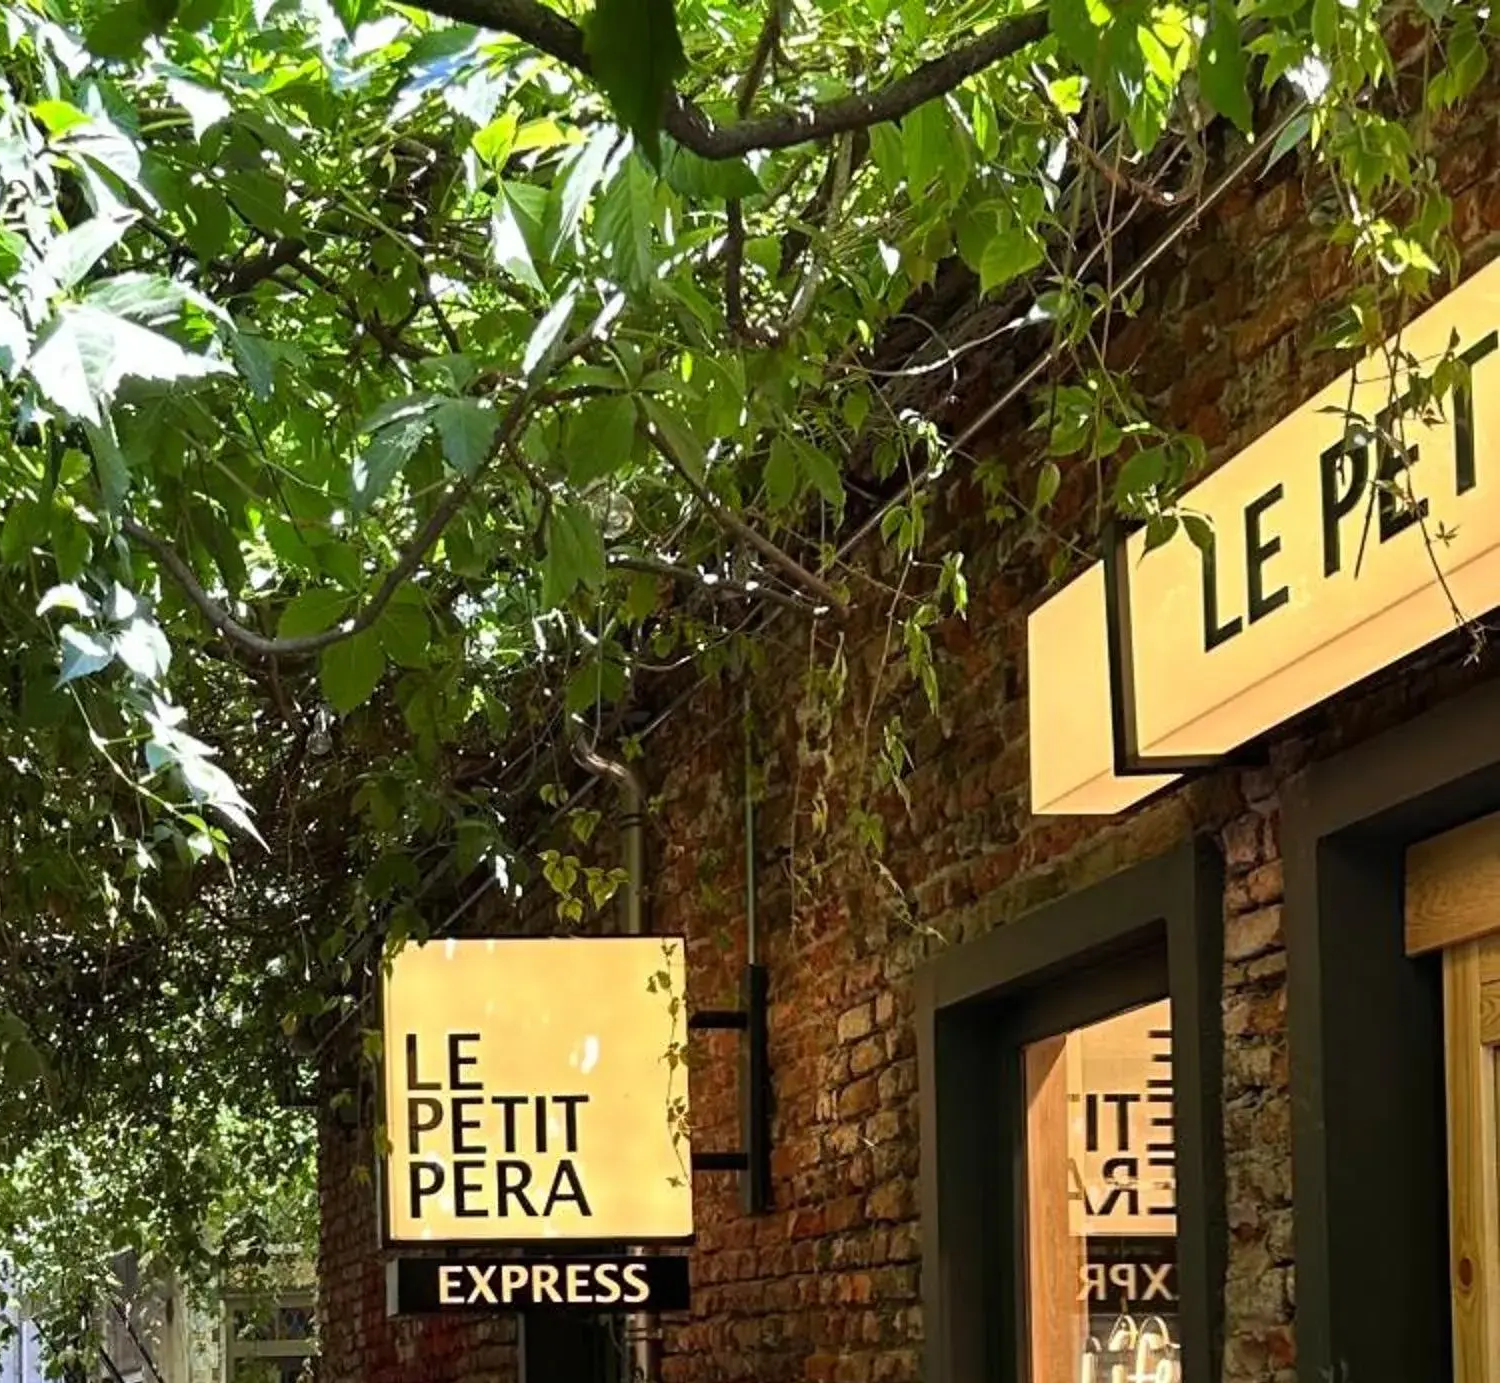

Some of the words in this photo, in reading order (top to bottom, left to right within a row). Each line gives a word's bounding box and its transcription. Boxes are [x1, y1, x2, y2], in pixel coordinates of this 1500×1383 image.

[1201, 483, 1289, 653] LE
[405, 1033, 484, 1090] LE
[407, 1095, 590, 1154] PETIT
[409, 1159, 592, 1218] PERA
[438, 1263, 650, 1304] EXPRESS
